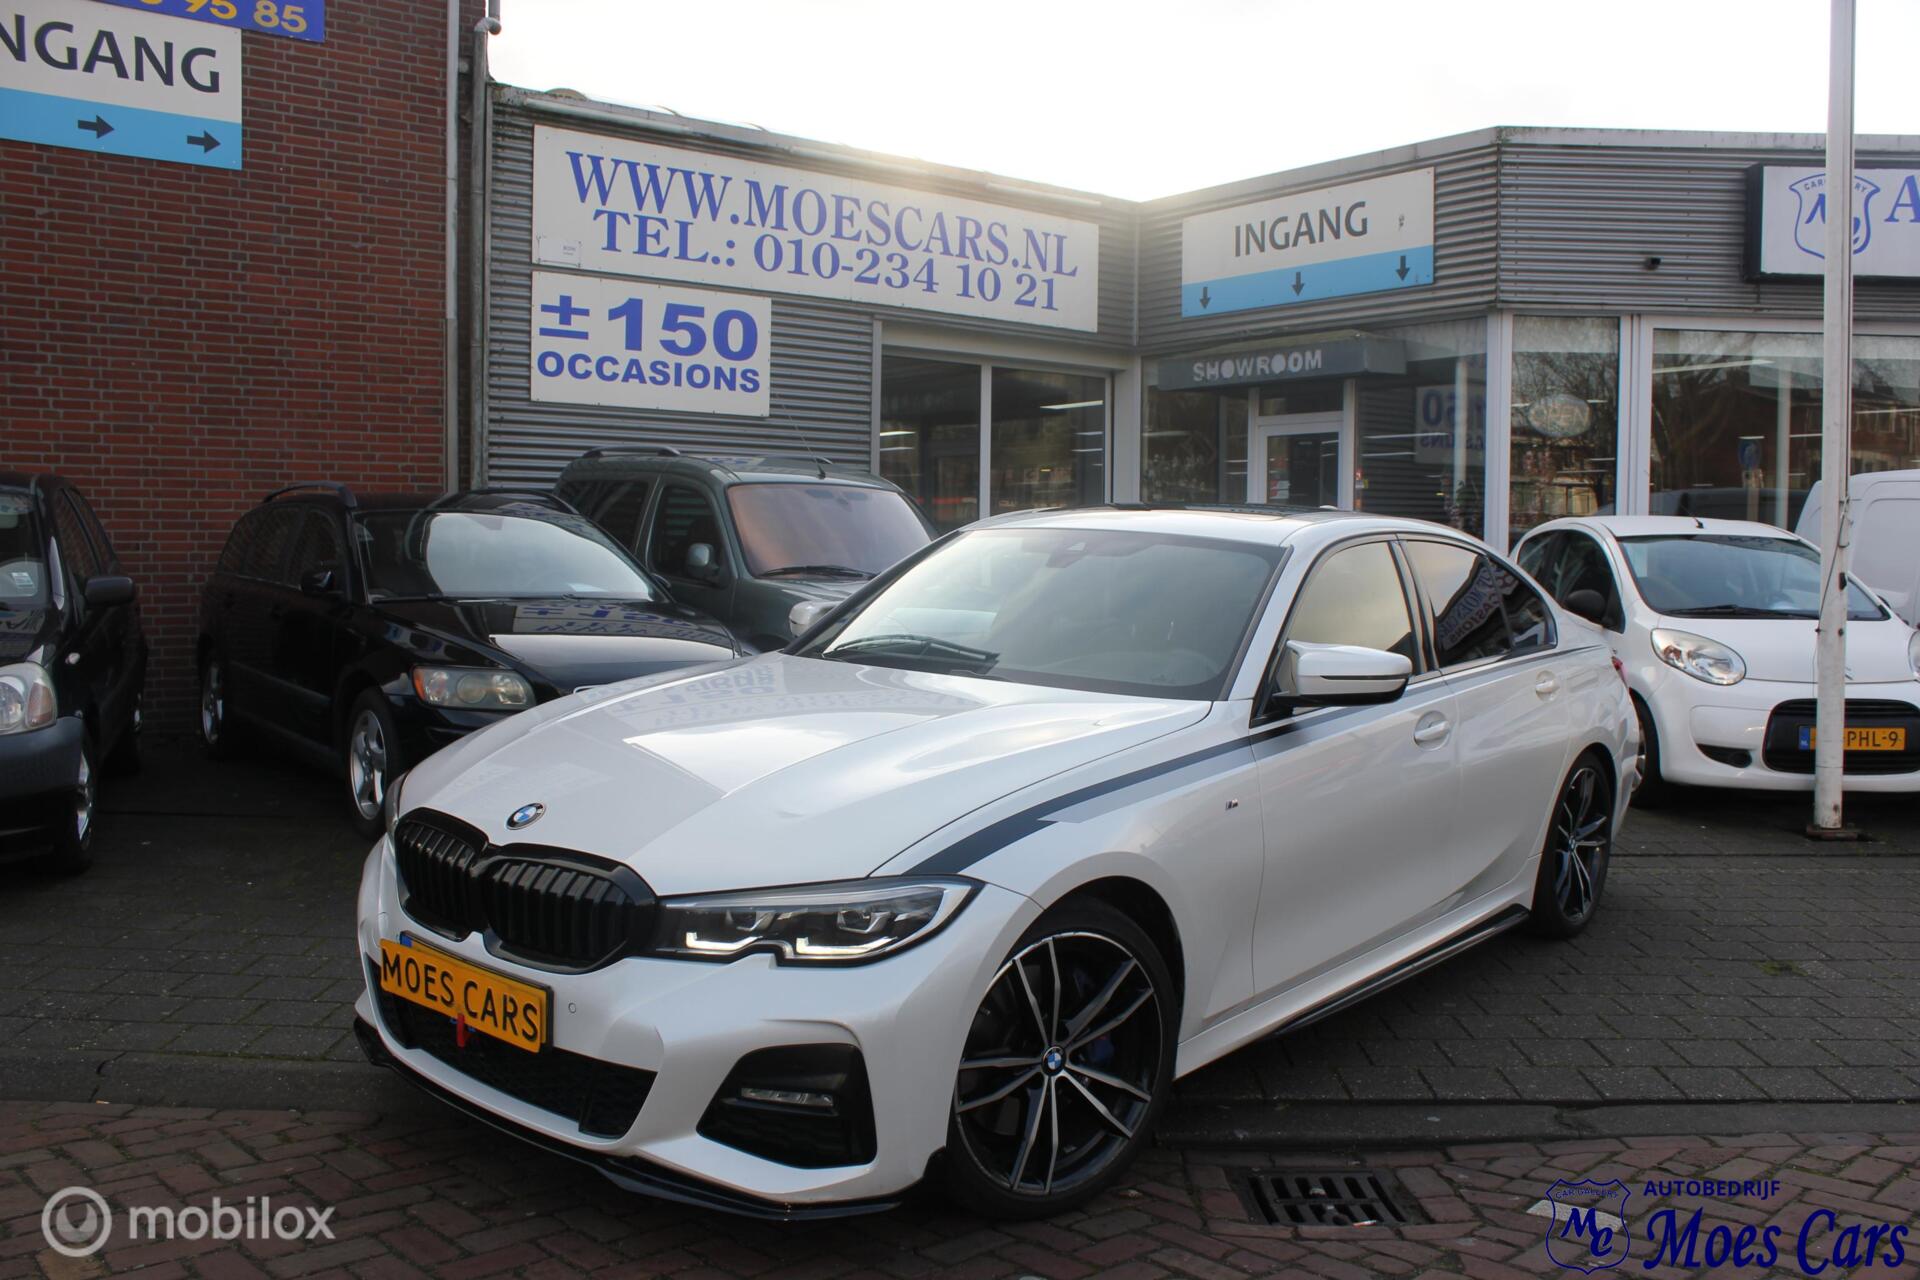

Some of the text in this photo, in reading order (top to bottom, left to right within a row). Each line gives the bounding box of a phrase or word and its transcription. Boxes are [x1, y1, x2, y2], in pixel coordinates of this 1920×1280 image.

[253, 0, 307, 33] 85
[565, 151, 1079, 278] WWW.MOESCARS.NL
[1234, 201, 1368, 257] INGANG
[593, 209, 1060, 312] TEL.: 010-234 10 21
[537, 351, 761, 393] OCCASIONS
[1192, 350, 1323, 382] SHOWROOM
[381, 948, 538, 1042] MOES CARS
